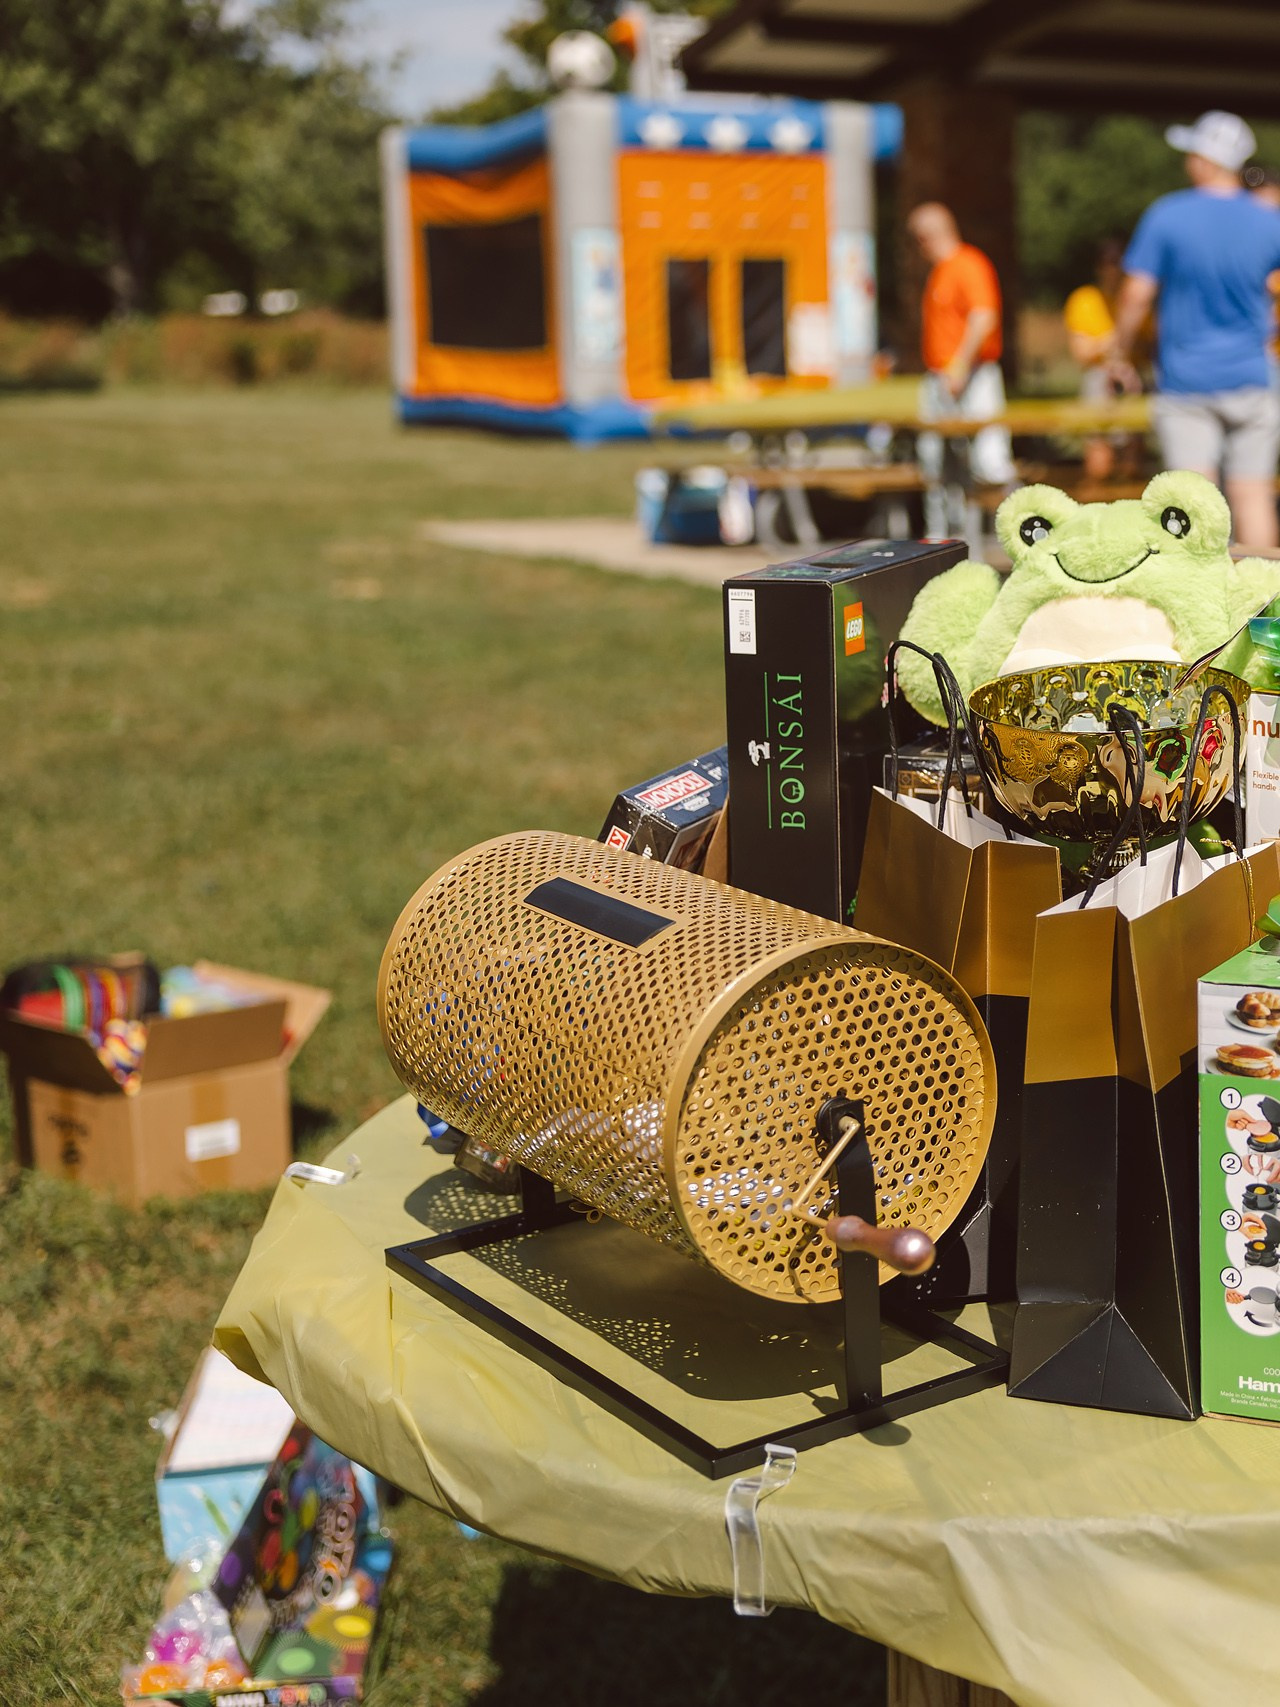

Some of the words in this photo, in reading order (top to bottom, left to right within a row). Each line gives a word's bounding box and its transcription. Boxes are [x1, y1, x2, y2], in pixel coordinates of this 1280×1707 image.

[845, 617, 862, 640] LEGO
[772, 673, 806, 830] BONSÁI
[1253, 770, 1279, 781] Flexible
[641, 773, 705, 808] MONOPOLY
[1253, 782, 1276, 791] handle
[1227, 1093, 1233, 1104] 1
[1226, 1157, 1235, 1169] 2
[1226, 1215, 1235, 1226] 3
[1226, 1272, 1236, 1283] 4
